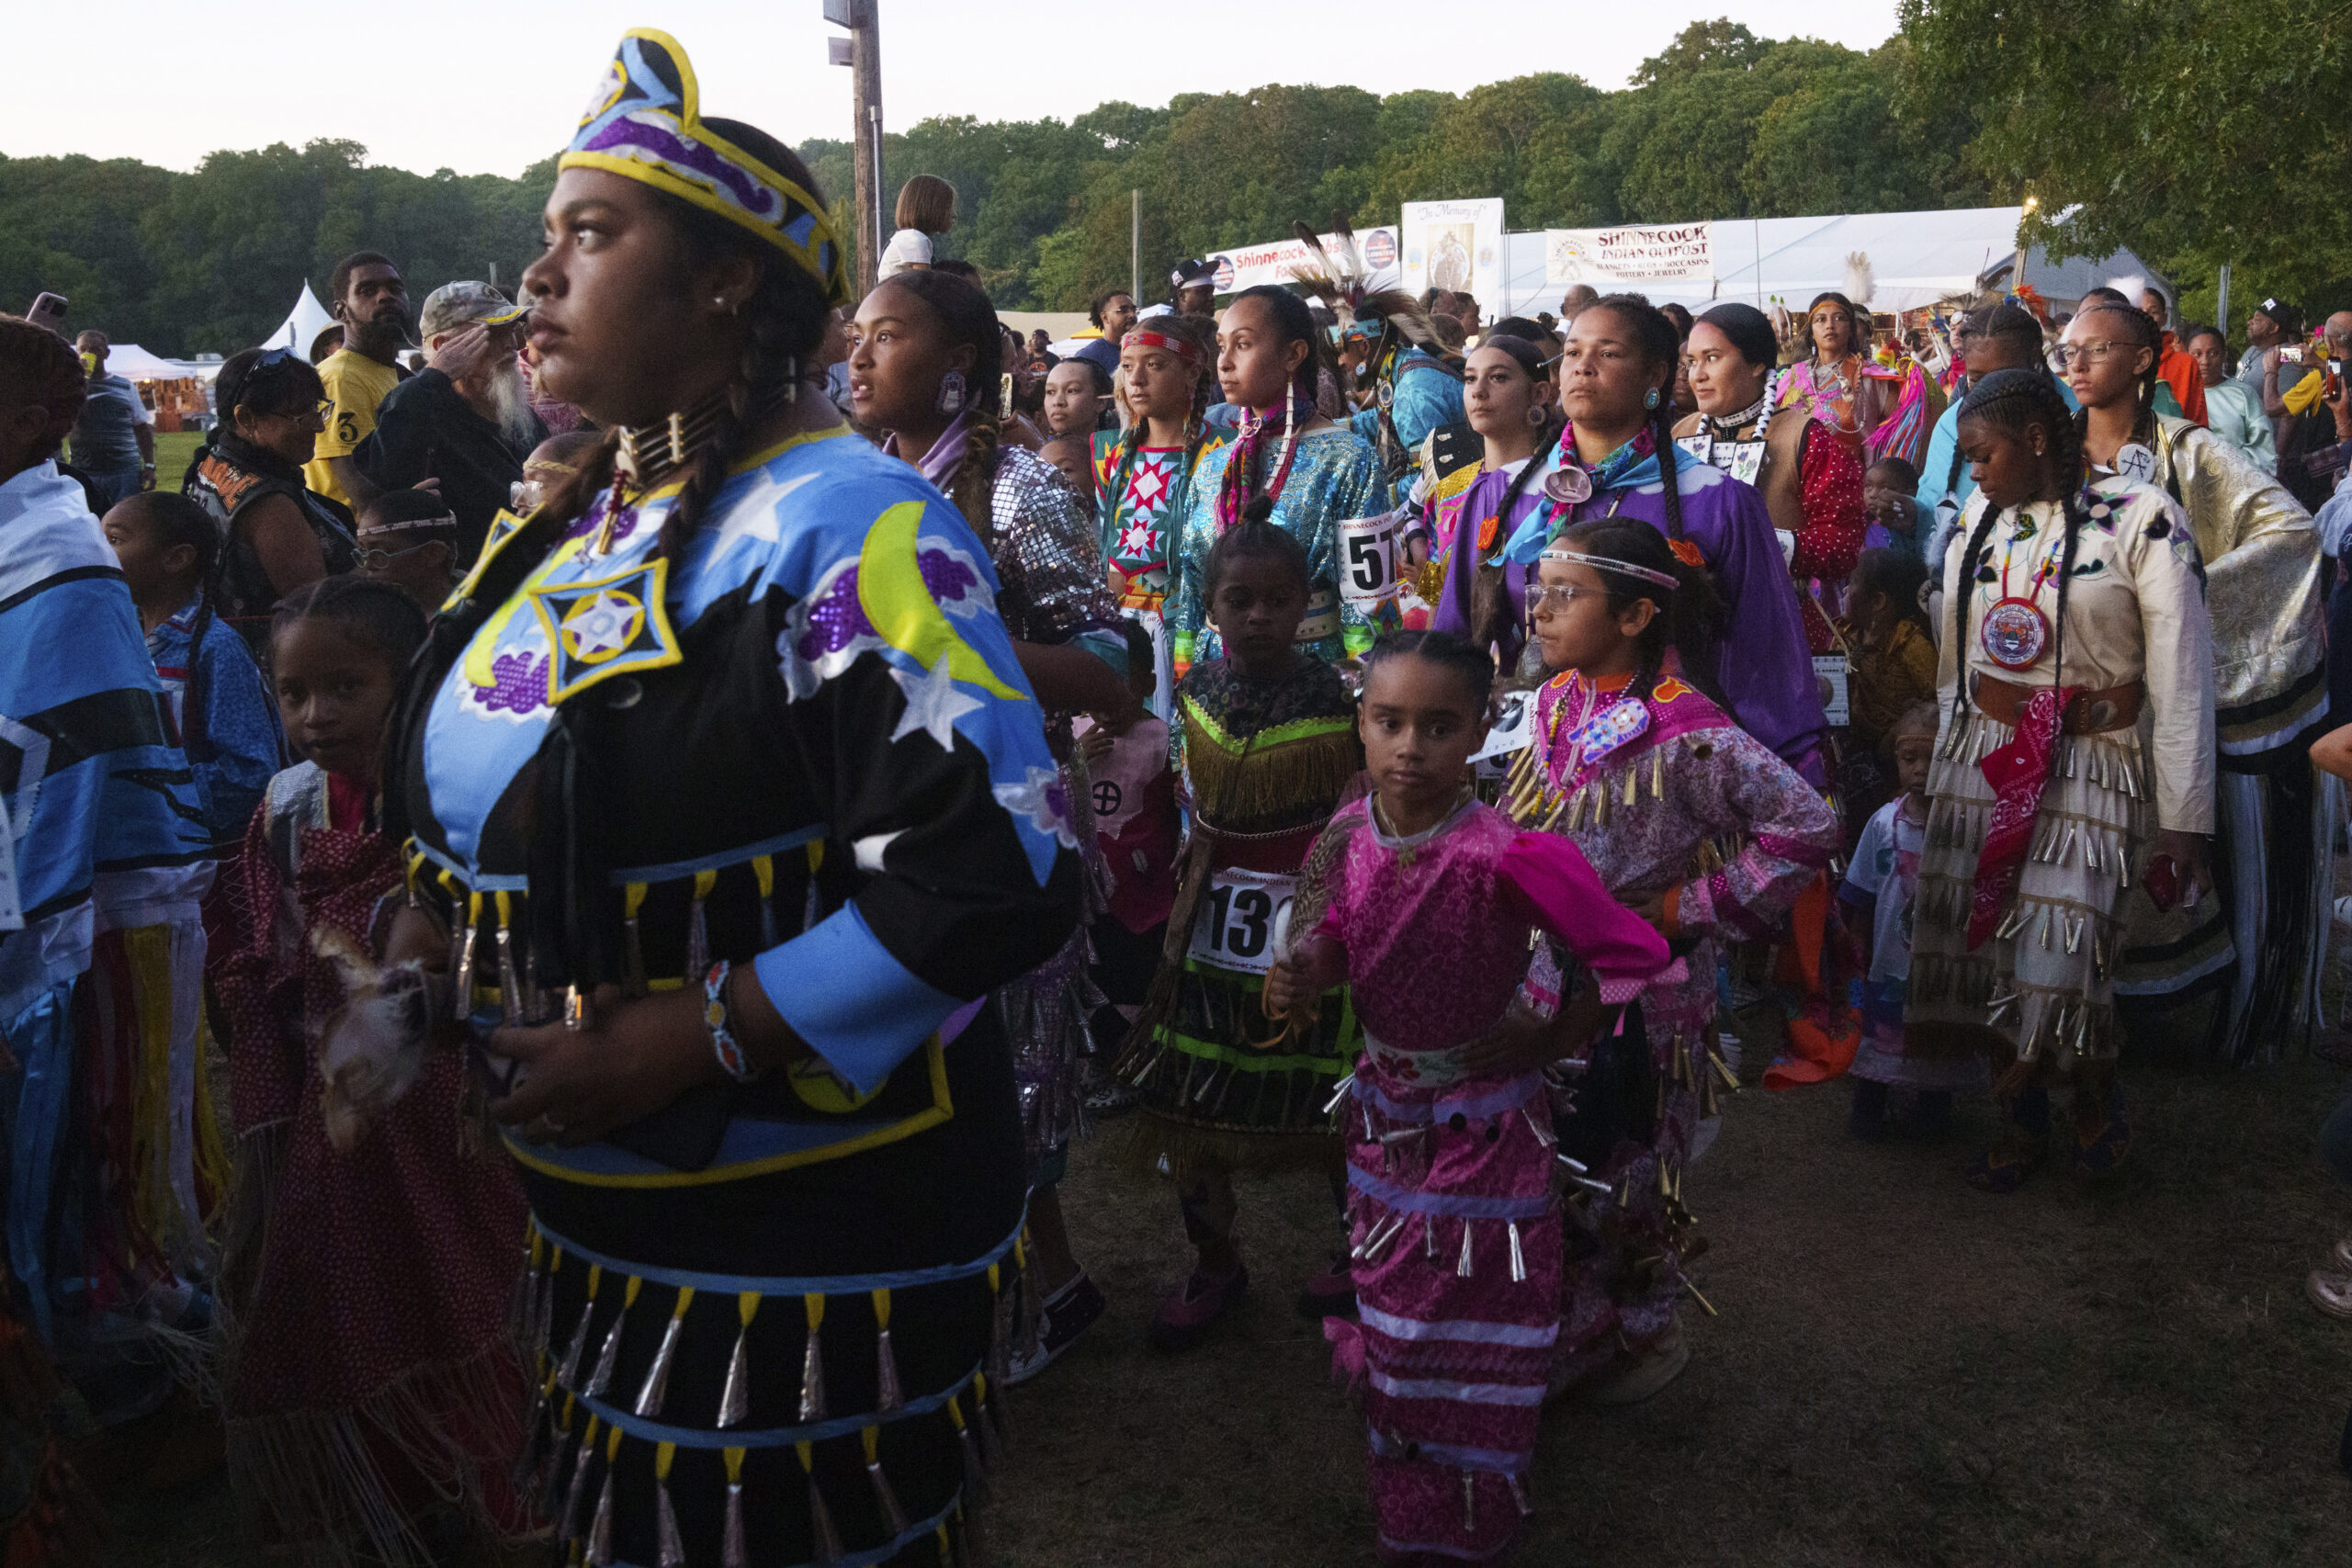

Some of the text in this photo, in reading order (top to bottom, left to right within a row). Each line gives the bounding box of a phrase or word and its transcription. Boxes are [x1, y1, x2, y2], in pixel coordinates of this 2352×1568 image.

[1435, 204, 1472, 220] Memory
[1598, 226, 1708, 246] SHINNECOCK
[1236, 245, 1306, 269] Shinnecock
[1602, 243, 1708, 259] INDIAN OUTPOST
[1664, 258, 1710, 267] MOCCASINS
[1616, 268, 1687, 278] POTTERY JEWELRY
[337, 412, 358, 442] 3
[1209, 885, 1295, 958] 13
